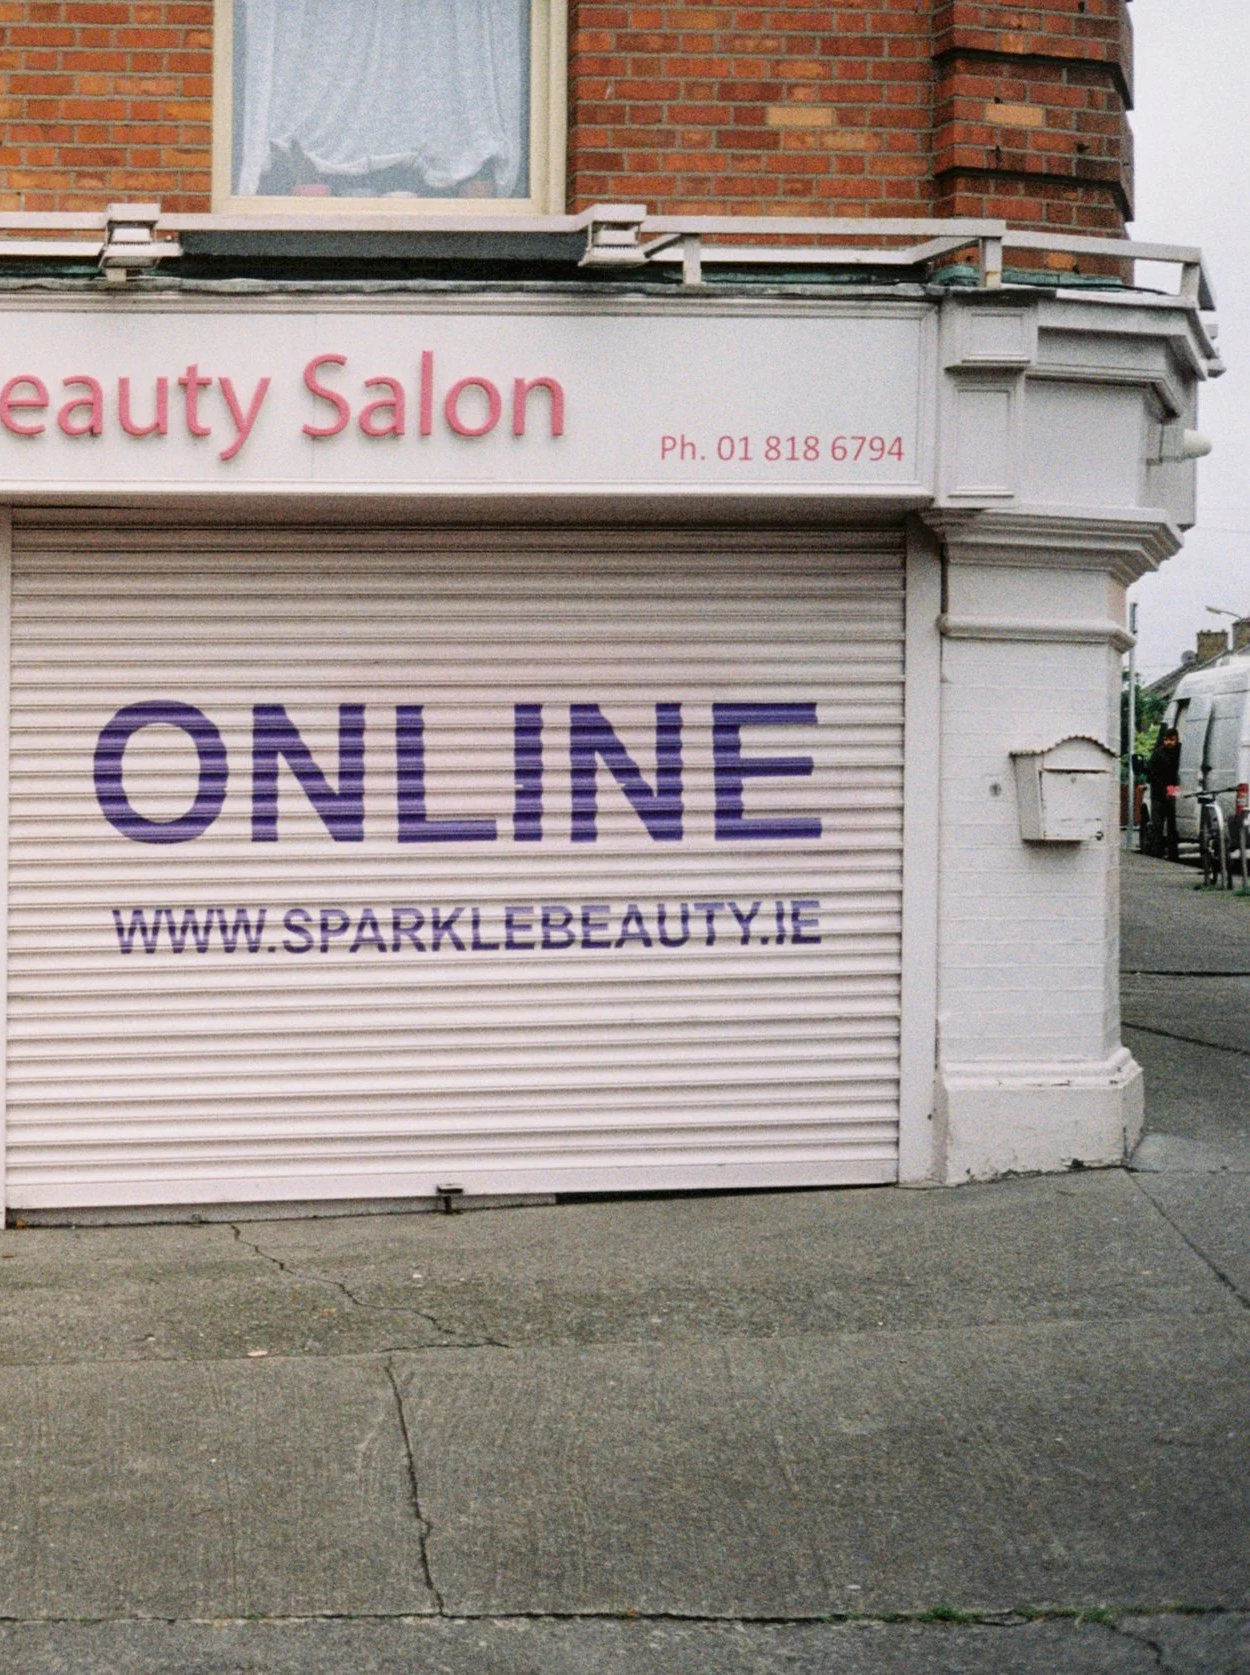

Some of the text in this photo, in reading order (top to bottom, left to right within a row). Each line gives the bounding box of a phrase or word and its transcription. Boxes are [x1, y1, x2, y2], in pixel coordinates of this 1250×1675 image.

[302, 351, 564, 437] Salon
[660, 435, 905, 461] Ph. 01 818 6794
[93, 699, 822, 845] ONLINE
[113, 900, 822, 955] WWW.SPARKLEBEAUTY.IE
